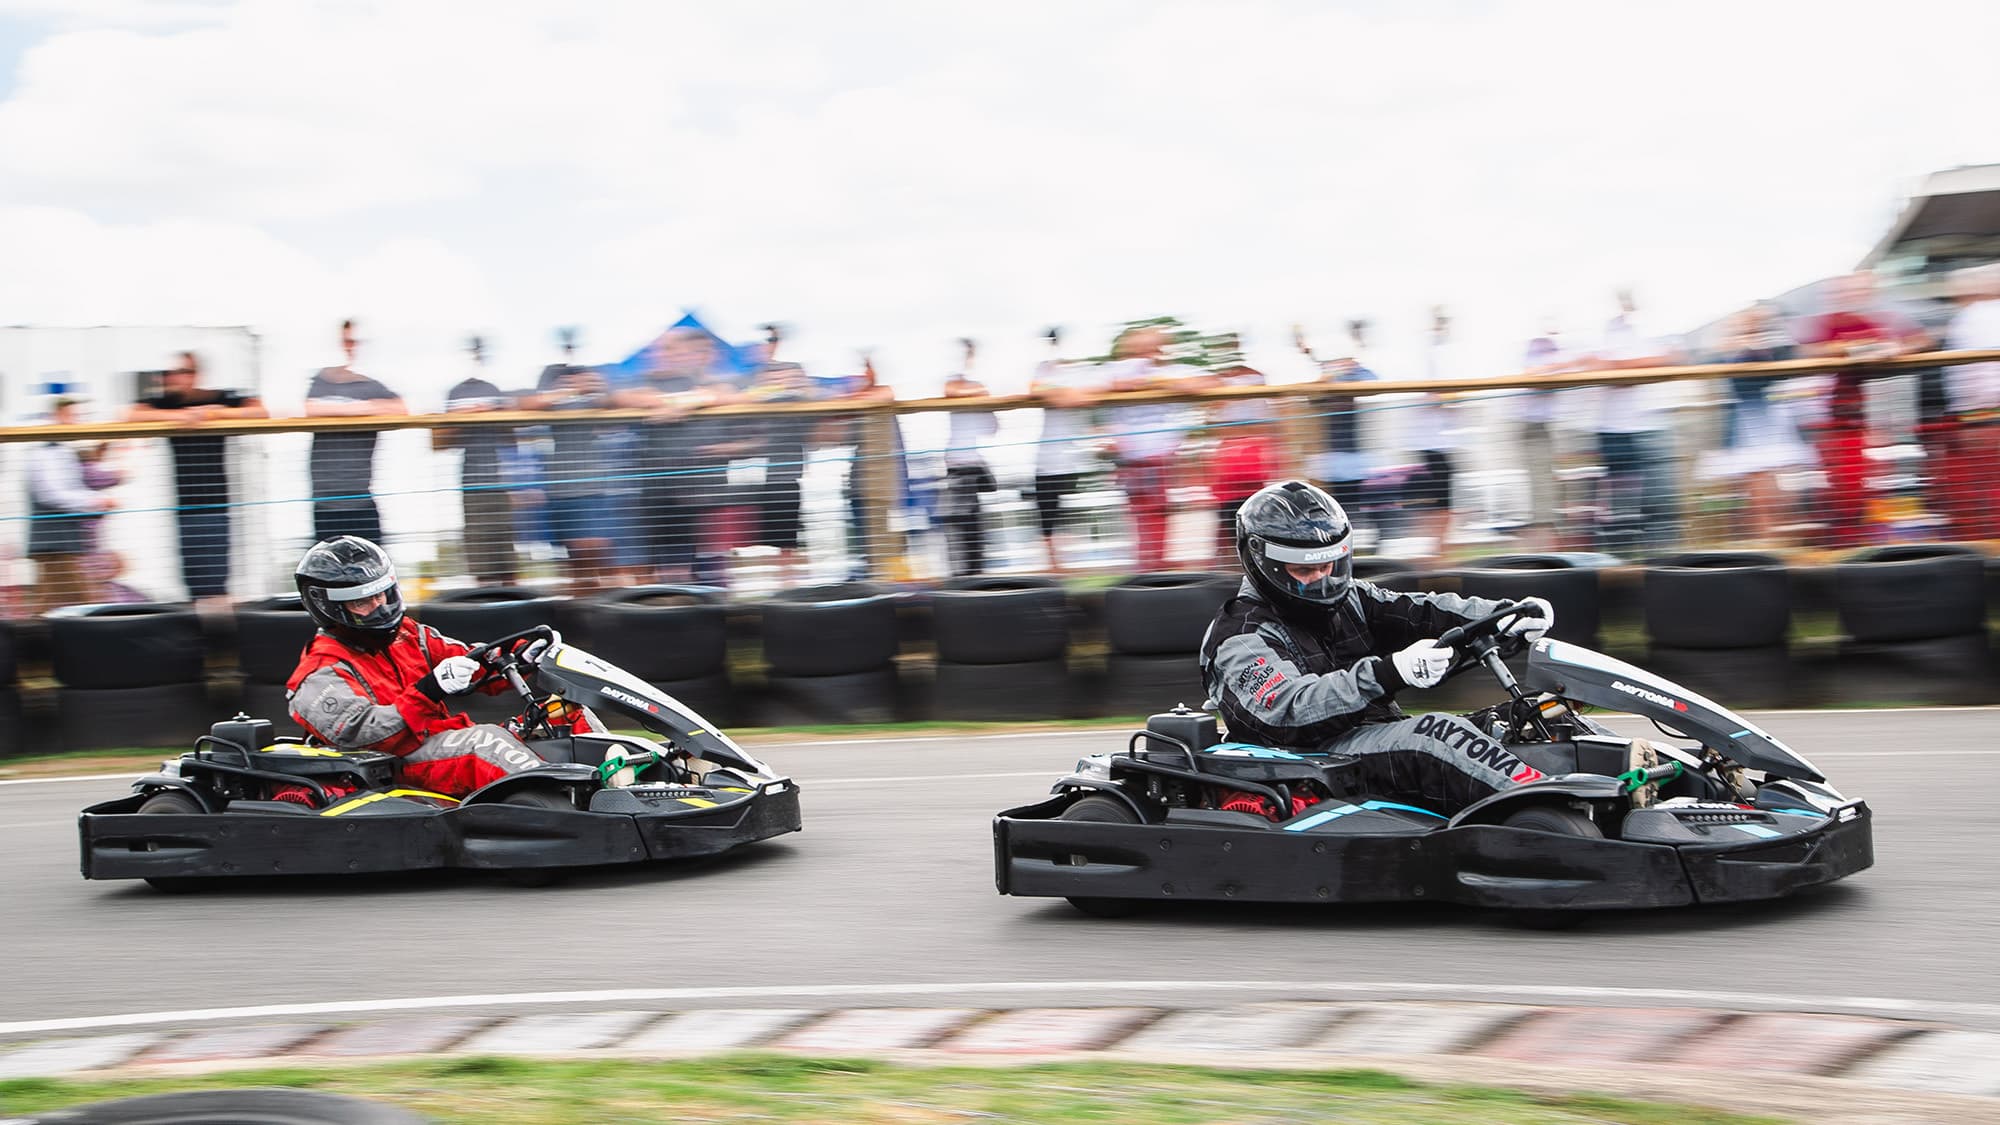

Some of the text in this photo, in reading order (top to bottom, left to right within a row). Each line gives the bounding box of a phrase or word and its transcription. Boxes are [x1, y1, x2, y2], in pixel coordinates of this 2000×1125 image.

[1304, 546, 1342, 561] DAYTONA
[600, 686, 650, 710] DAYTONA
[1610, 681, 1675, 709] DAYTONA
[1413, 715, 1521, 777] DAYTONA
